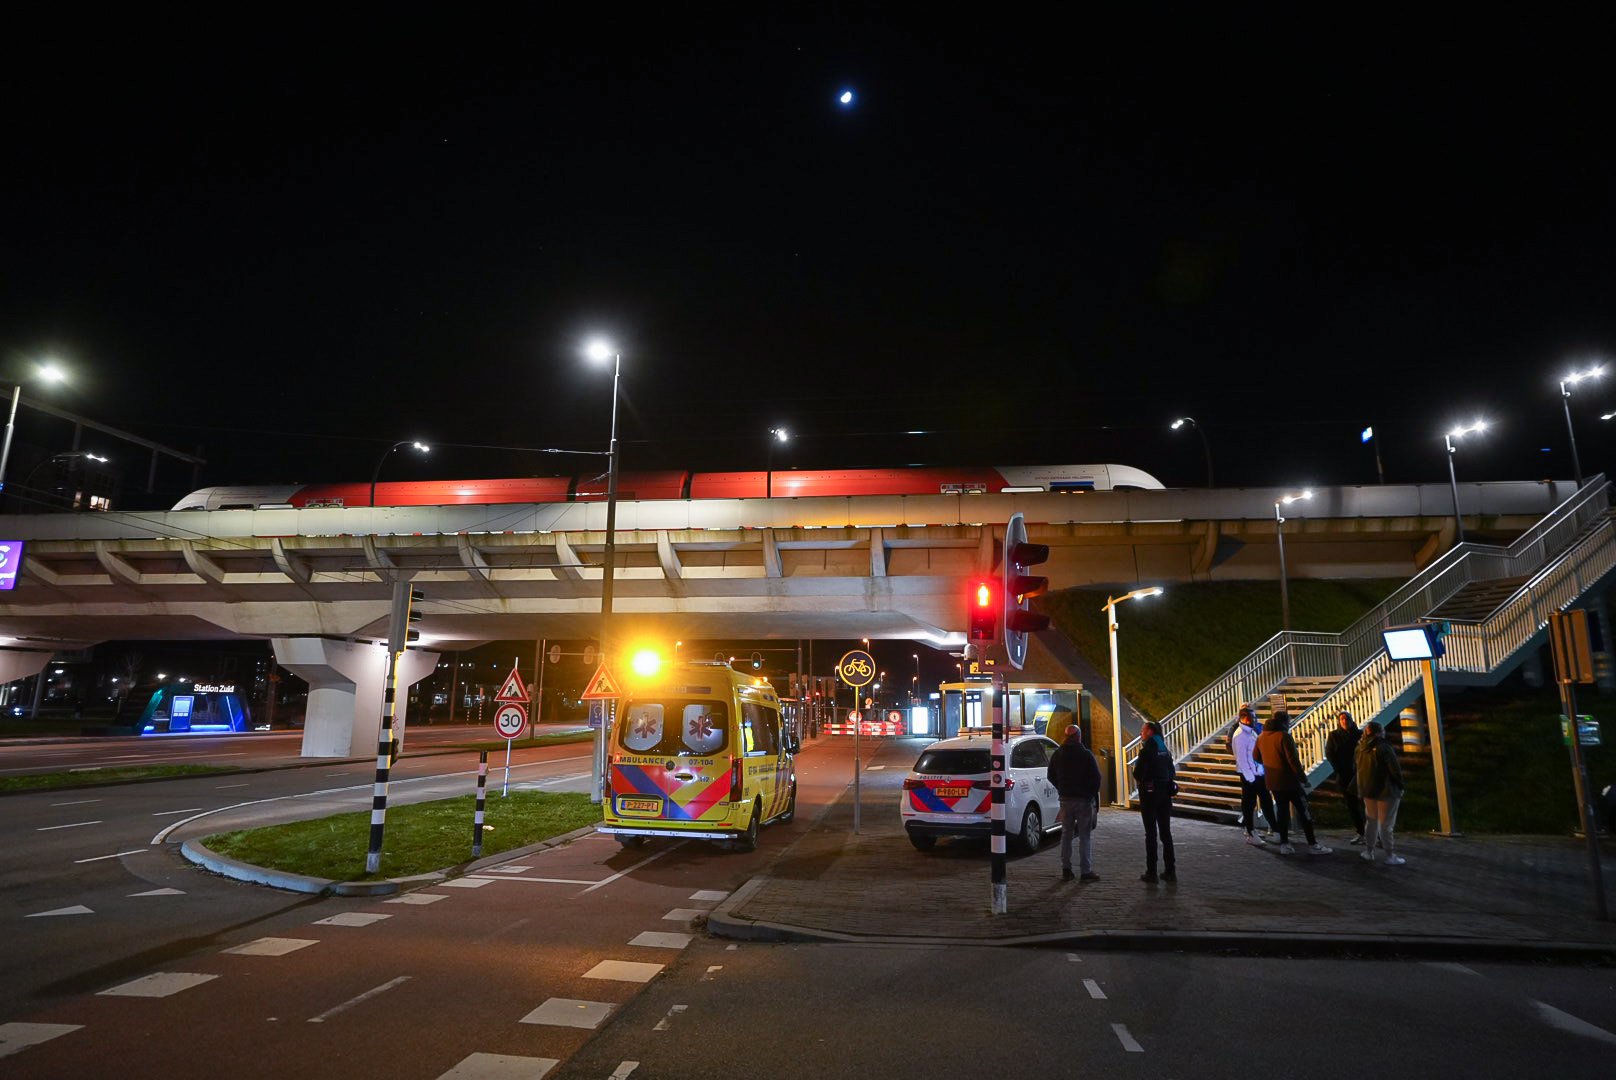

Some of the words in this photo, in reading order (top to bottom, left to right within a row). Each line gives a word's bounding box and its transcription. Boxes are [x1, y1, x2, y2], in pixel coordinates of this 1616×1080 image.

[194, 684, 218, 692] Station
[500, 713, 521, 728] 30
[688, 758, 714, 766] 07-104
